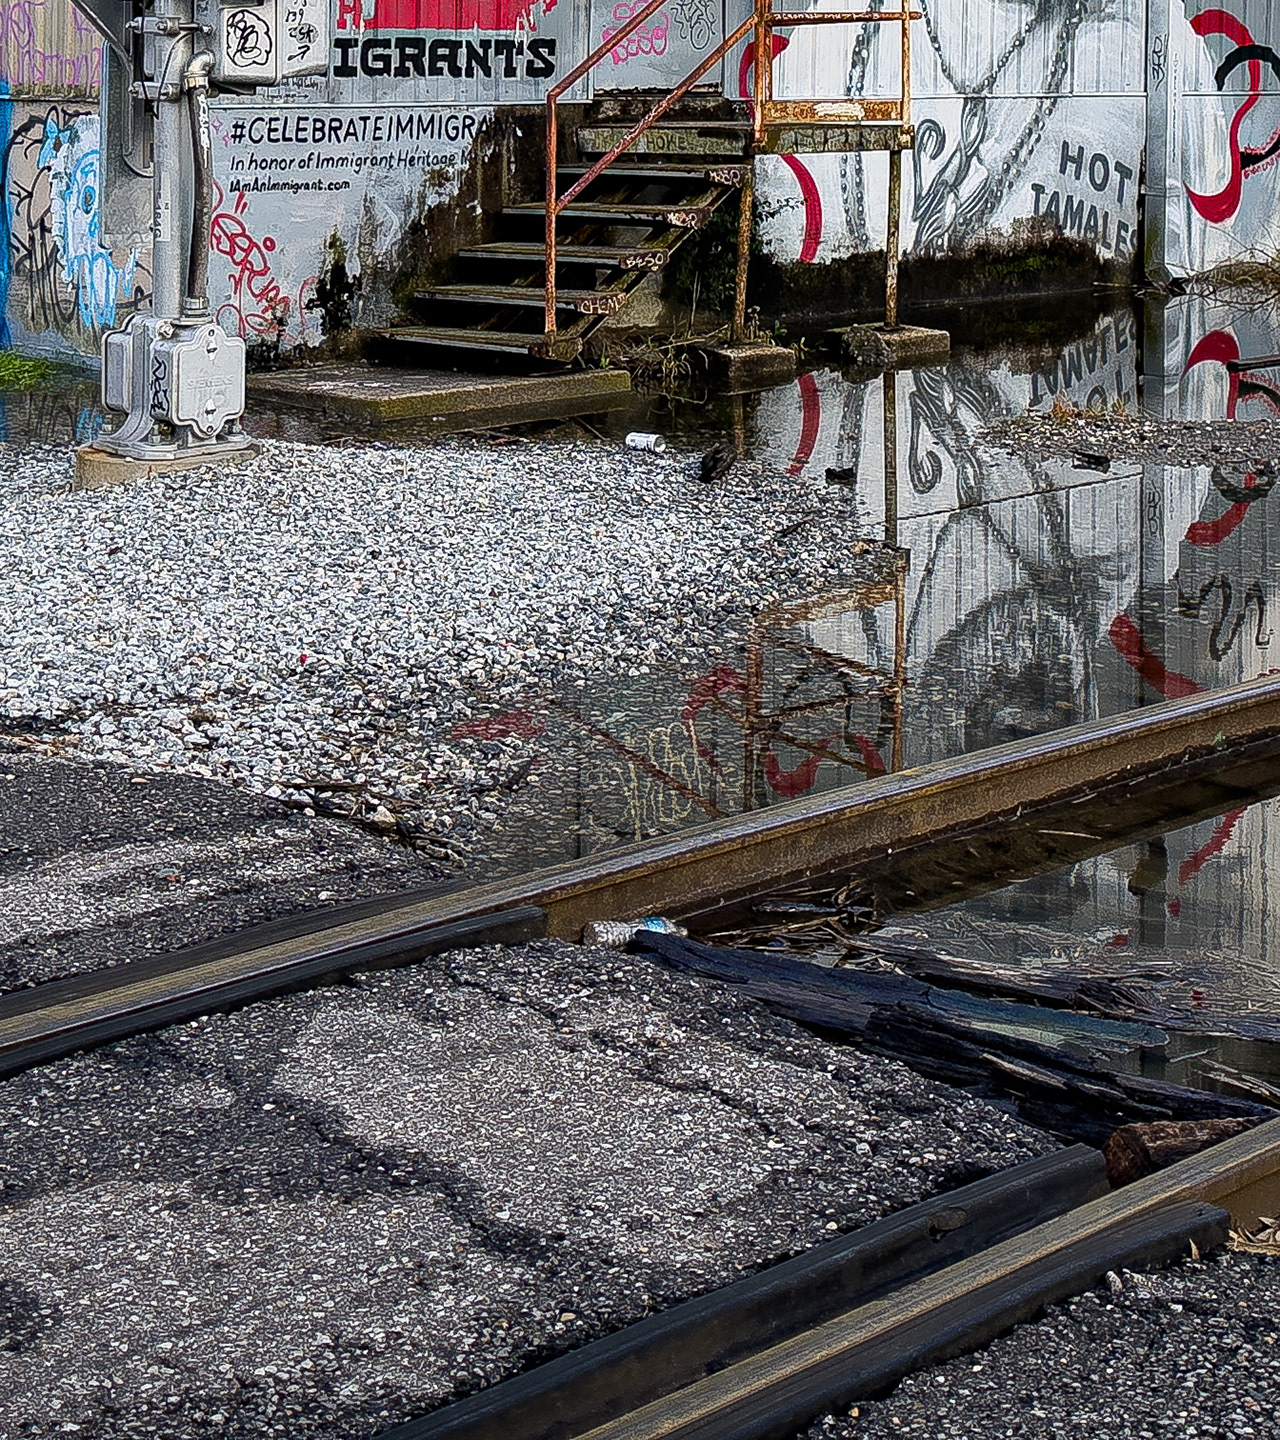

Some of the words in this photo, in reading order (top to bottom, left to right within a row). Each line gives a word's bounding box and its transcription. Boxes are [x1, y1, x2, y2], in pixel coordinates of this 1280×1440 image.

[332, 37, 557, 79] IGRANTS
[230, 155, 245, 171] In
[247, 152, 296, 171] honor
[298, 151, 315, 170] of
[315, 148, 395, 175] Immigrant
[1058, 139, 1133, 206] HOT
[229, 175, 351, 195] IAmAnImmigrant.com
